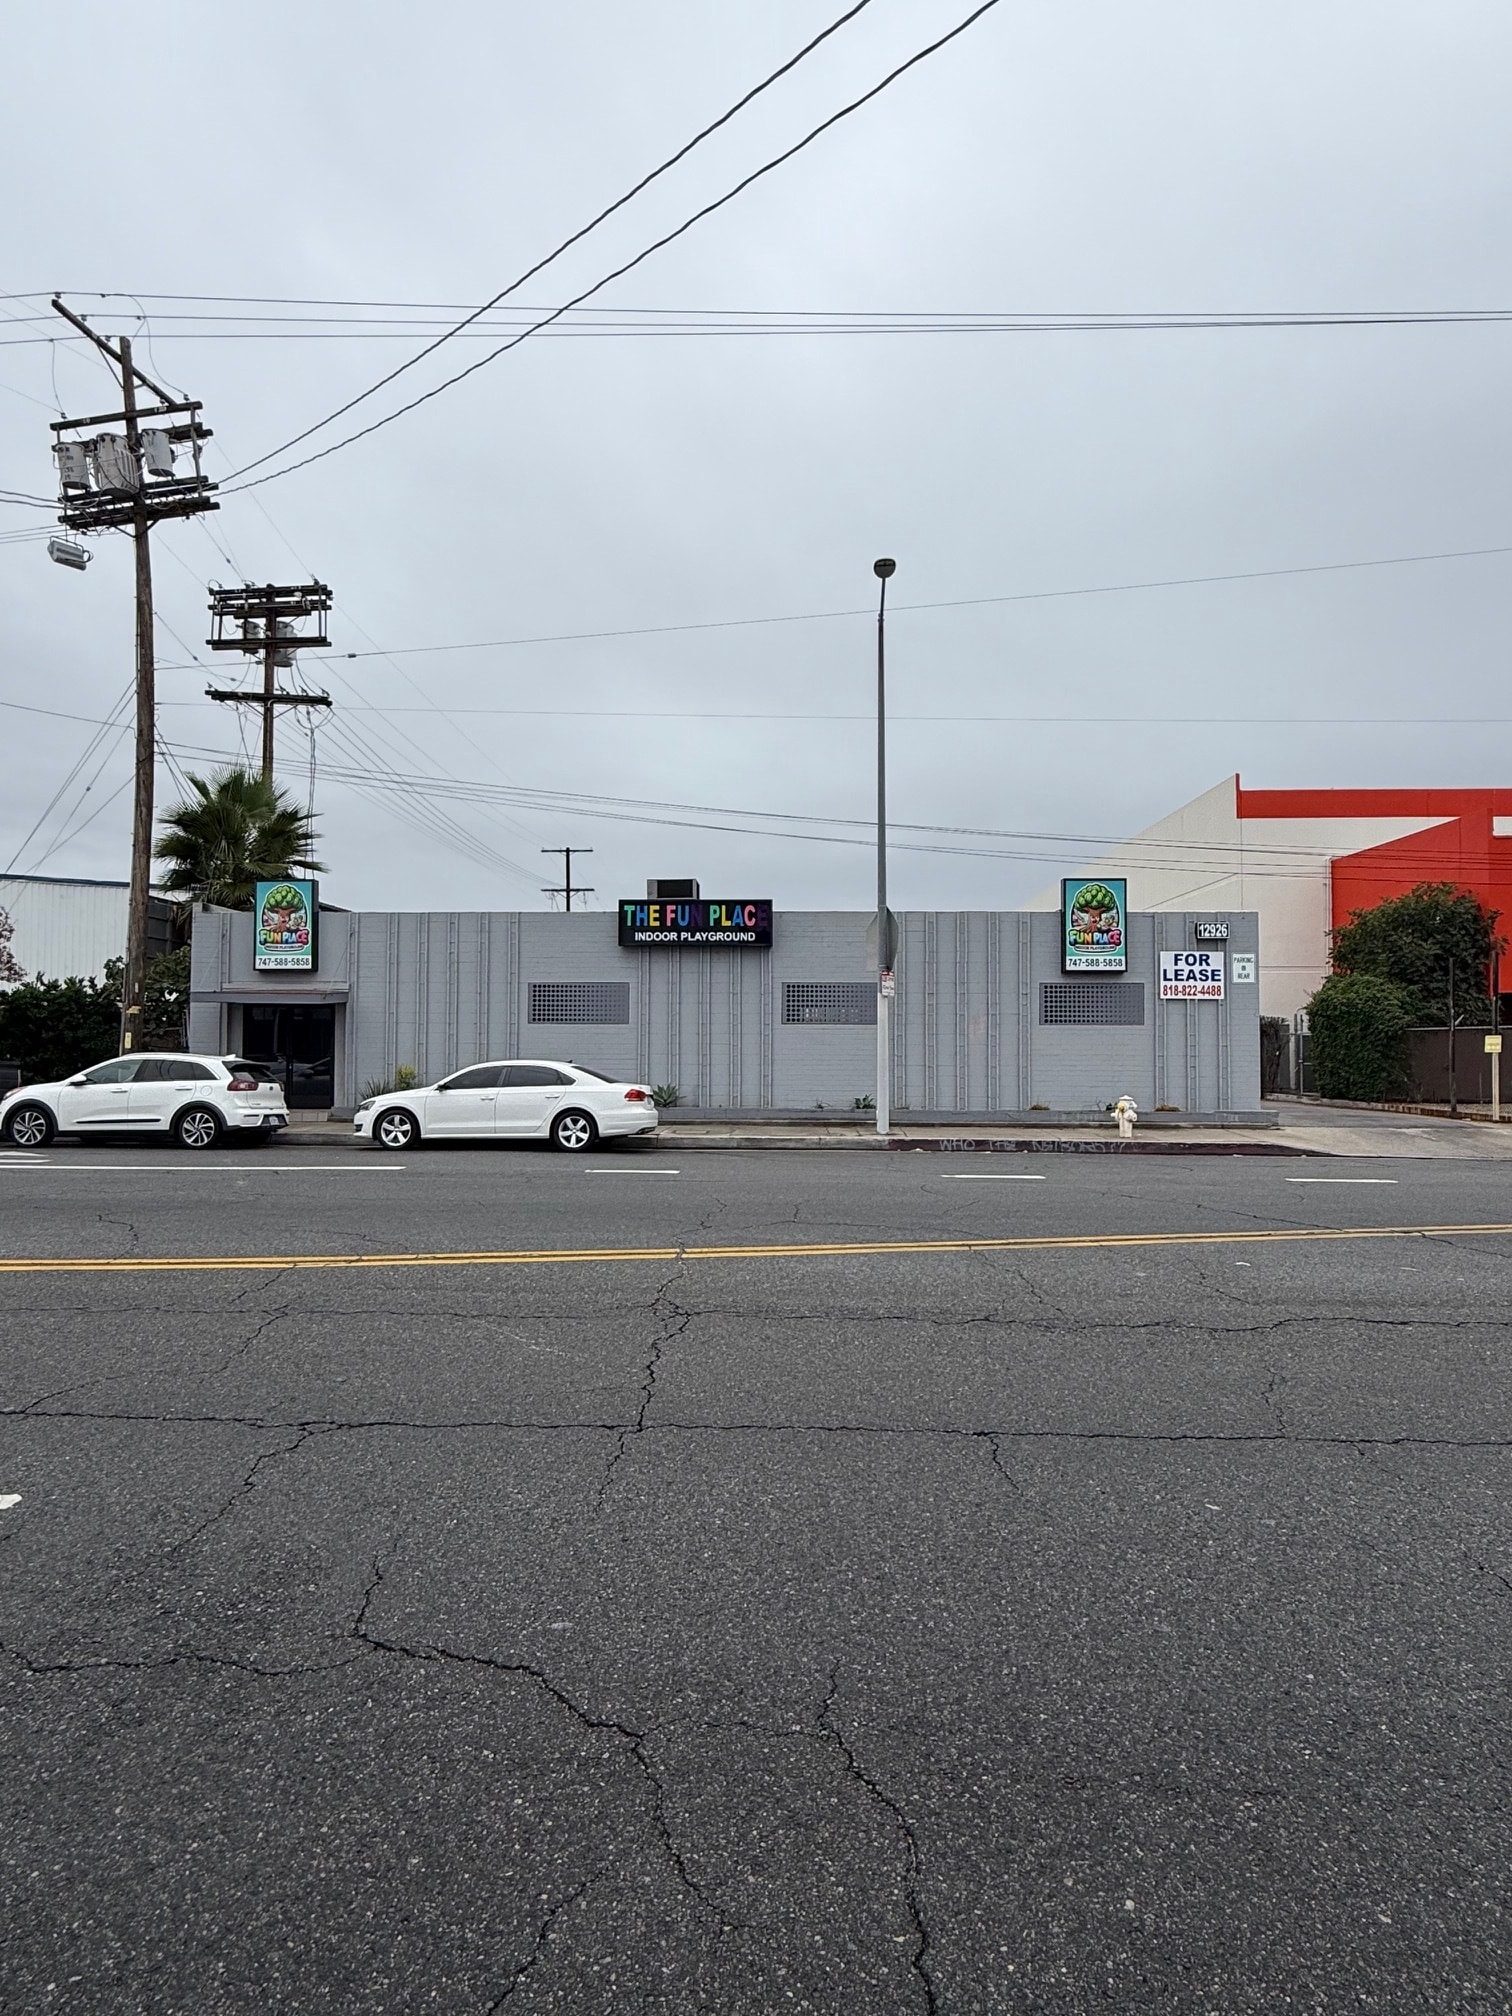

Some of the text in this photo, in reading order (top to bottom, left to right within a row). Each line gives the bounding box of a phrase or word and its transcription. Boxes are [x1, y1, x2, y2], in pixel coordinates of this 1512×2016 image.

[624, 905, 769, 927] THE FUN PLACE
[260, 930, 308, 944] FUN PLACE
[634, 931, 756, 942] INDOOR PLAYGROUND
[1069, 930, 1120, 944] FUN PLACE
[1199, 924, 1228, 937] 12926
[258, 958, 310, 966] 747-588-5858
[1068, 958, 1123, 967] 747-588-5858
[1173, 953, 1211, 967] FOR
[1162, 969, 1222, 982] LEASE
[1162, 984, 1222, 997] 818-822-4488
[939, 1139, 976, 1151] WHO
